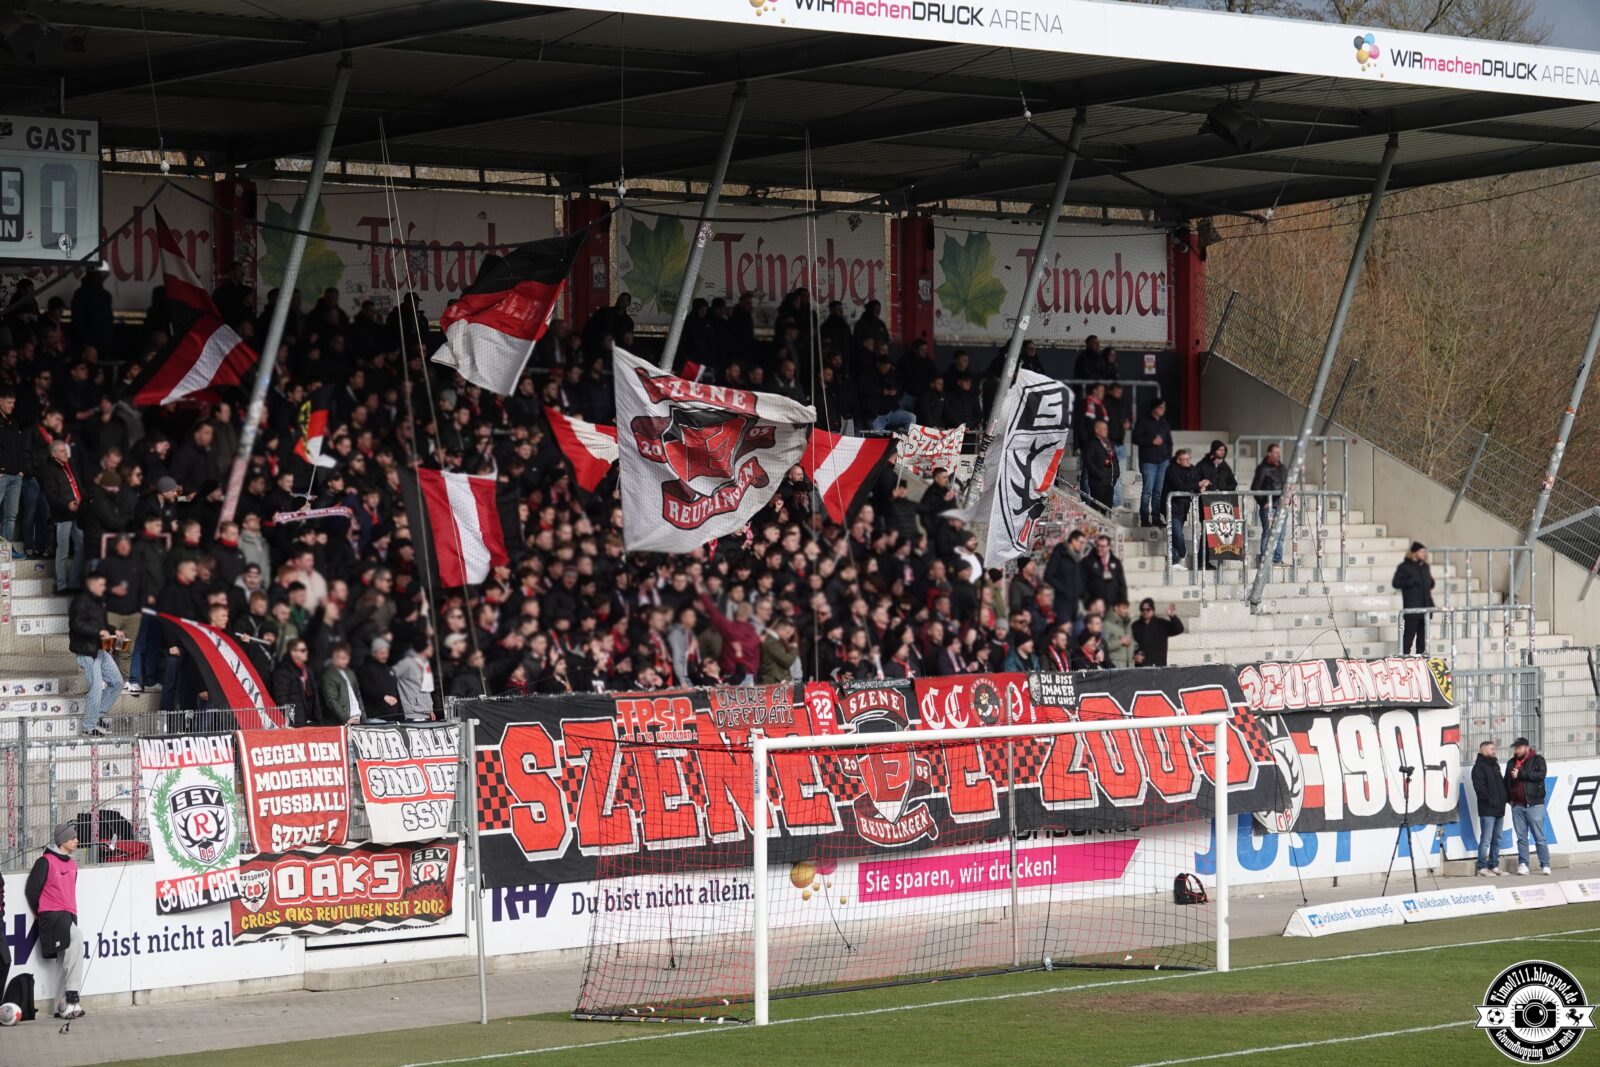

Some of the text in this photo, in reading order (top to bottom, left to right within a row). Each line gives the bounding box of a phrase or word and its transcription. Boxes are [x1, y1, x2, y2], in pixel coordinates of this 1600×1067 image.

[989, 9, 1064, 34] ARENA
[1390, 48, 1538, 81] WIRmachenDRUCK
[26, 126, 91, 152] GAST
[668, 462, 755, 525] REUTLINGEN
[1042, 685, 1075, 697] IMMER
[1056, 674, 1073, 685] BIST
[813, 697, 833, 720] 22
[850, 689, 900, 714] SZENE
[616, 697, 692, 736] TPSP
[716, 706, 794, 729] DIFFIDATI
[138, 735, 234, 769] INDEPENDENT
[251, 742, 341, 767] GEGEN DEN
[352, 730, 408, 760] WIR
[254, 766, 345, 792] MODERNEN
[500, 716, 843, 861] SZENE
[1040, 684, 1257, 810] 2005
[1308, 709, 1460, 821] 1905
[367, 766, 427, 797] SIND
[176, 789, 220, 811] SSV
[259, 792, 346, 817] FUSSBALL!
[193, 812, 213, 836] R
[401, 800, 449, 831] SSV
[860, 810, 928, 839] REUTLINGEN
[414, 850, 446, 862] SSV
[276, 860, 400, 899] OAKS
[423, 863, 434, 880] R
[866, 854, 1058, 892] Sie sparen, wir drucken!
[176, 876, 208, 910] NBZ
[572, 877, 756, 916] Du bist nicht allein.
[241, 911, 281, 930] CROSS
[316, 903, 383, 922] REUTLINGEN
[388, 899, 409, 918] SEIT
[413, 899, 445, 916] 2002
[97, 931, 141, 958] bist
[147, 924, 205, 953] nicht
